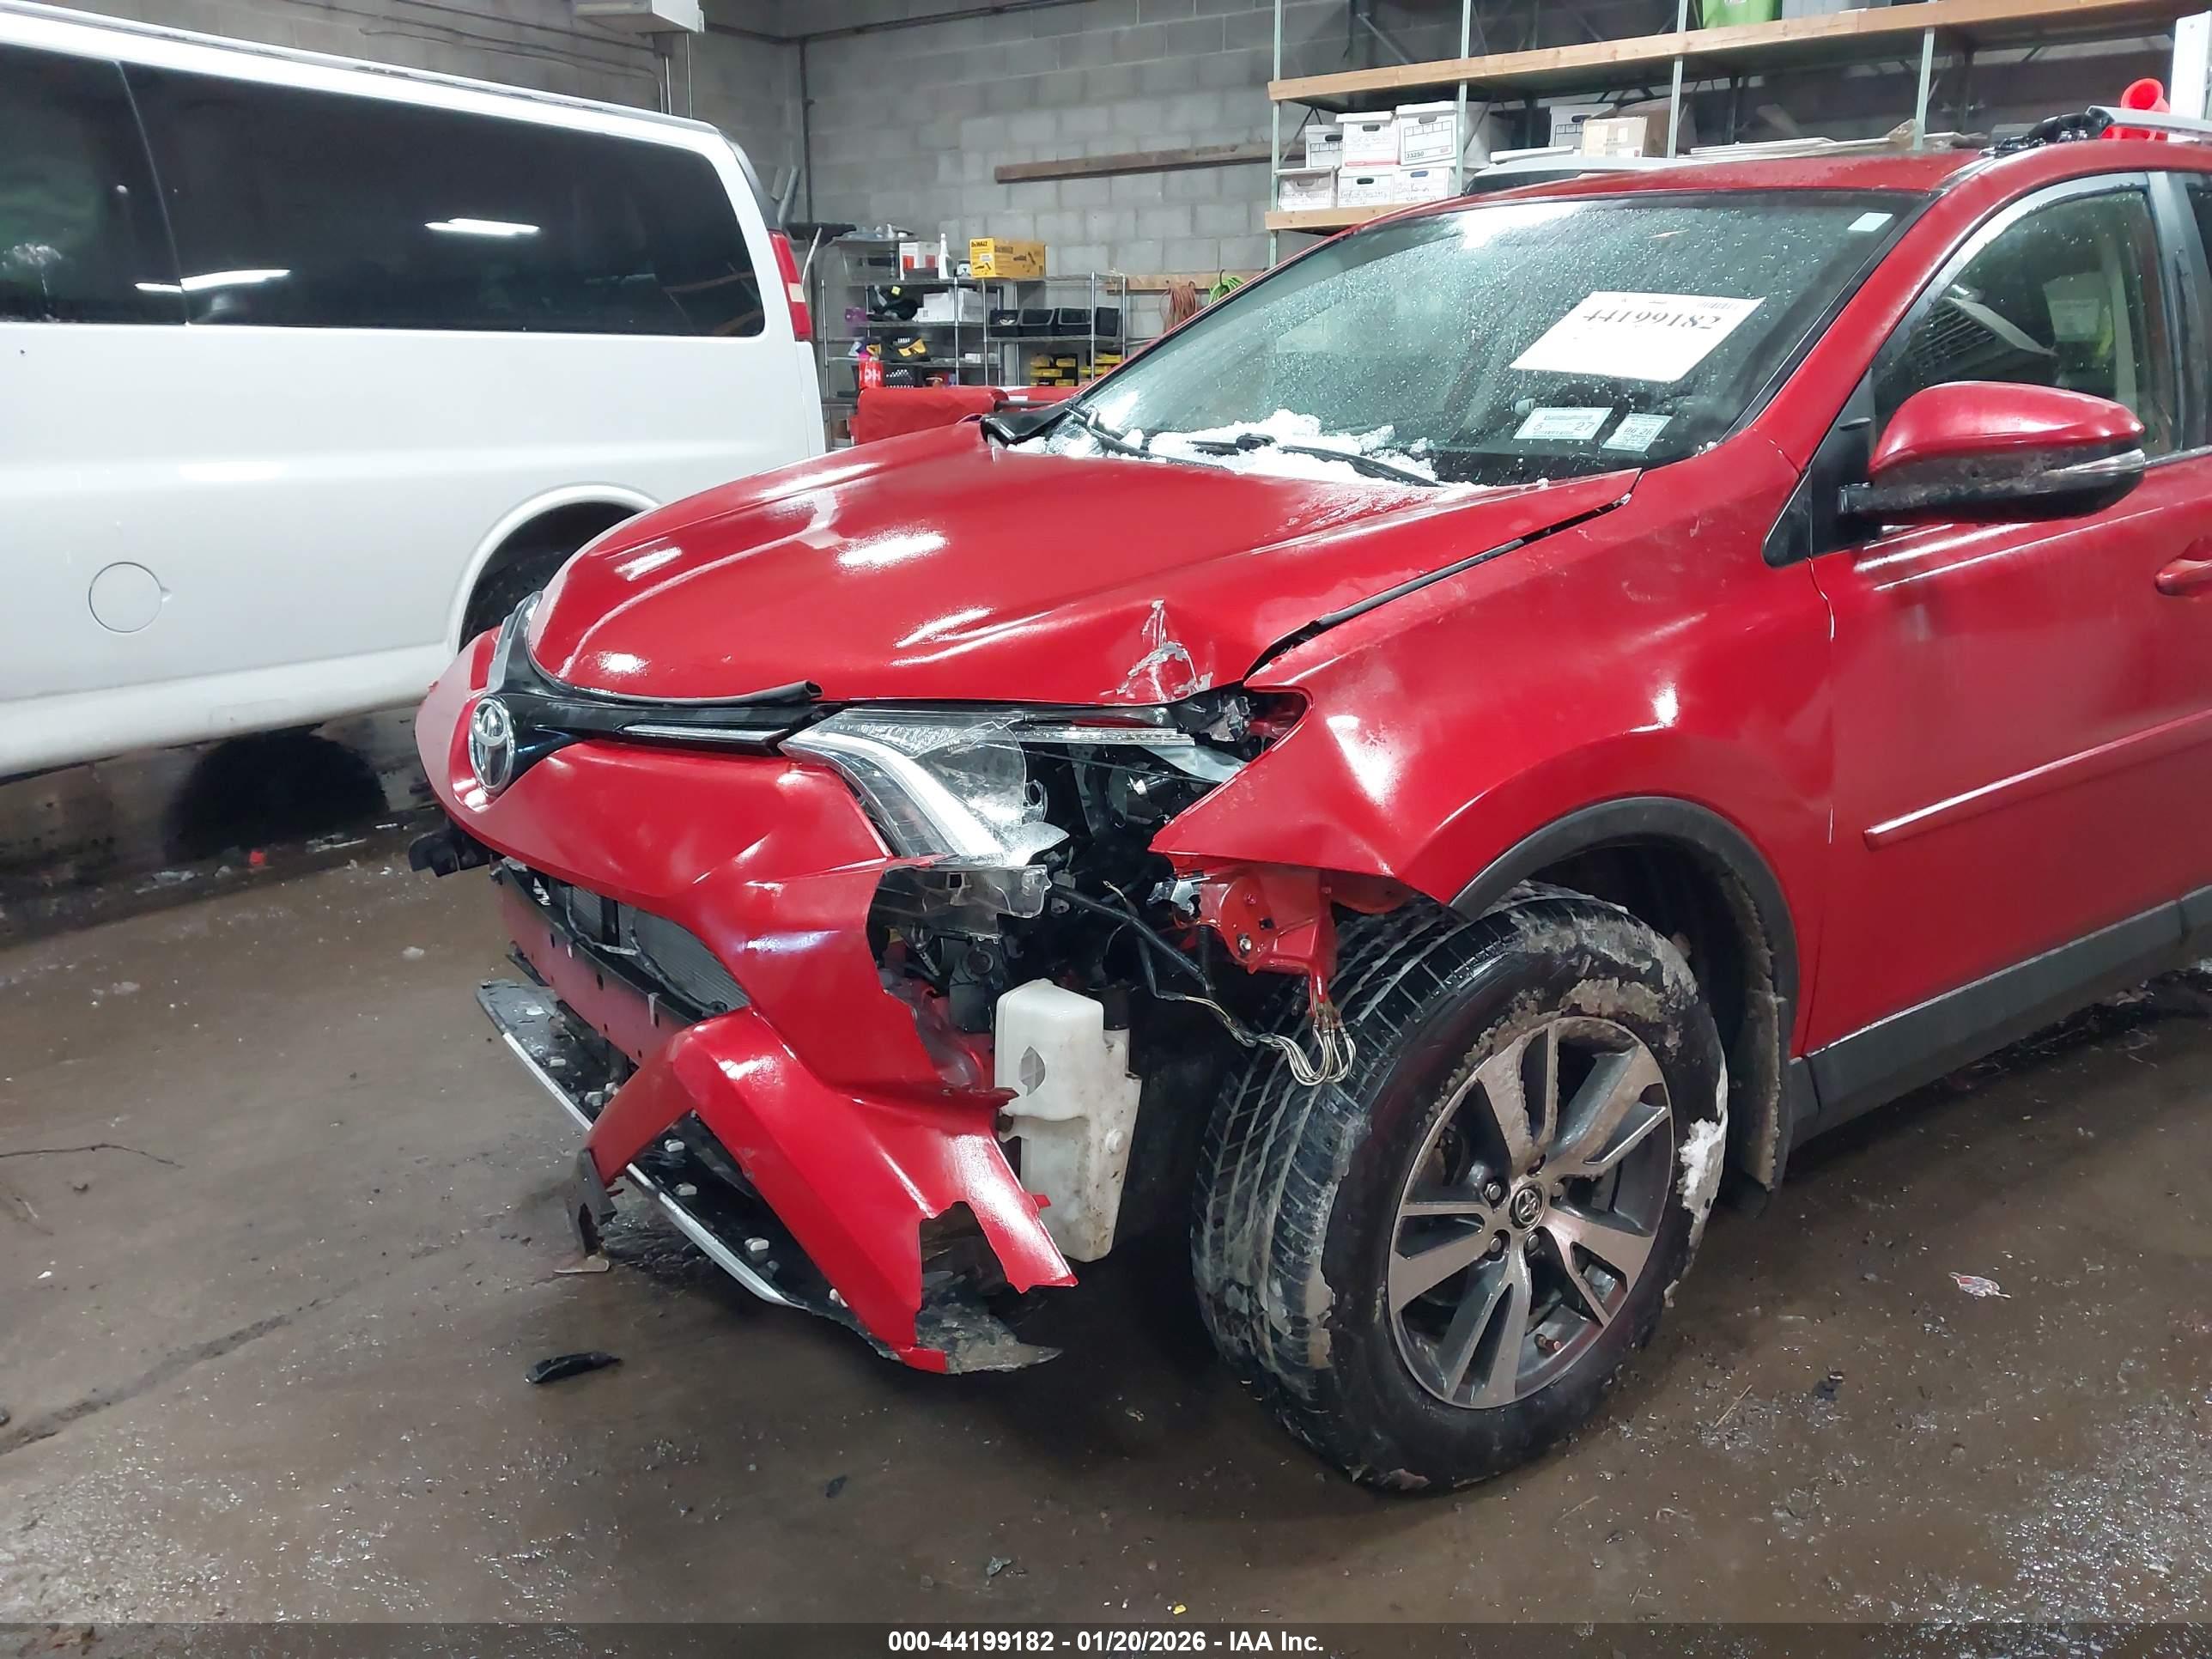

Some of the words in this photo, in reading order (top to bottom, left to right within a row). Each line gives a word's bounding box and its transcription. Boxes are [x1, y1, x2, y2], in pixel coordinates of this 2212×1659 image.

[1583, 309, 1722, 330] 44199182
[1533, 422, 1545, 431] 5
[1573, 421, 1595, 432] 27
